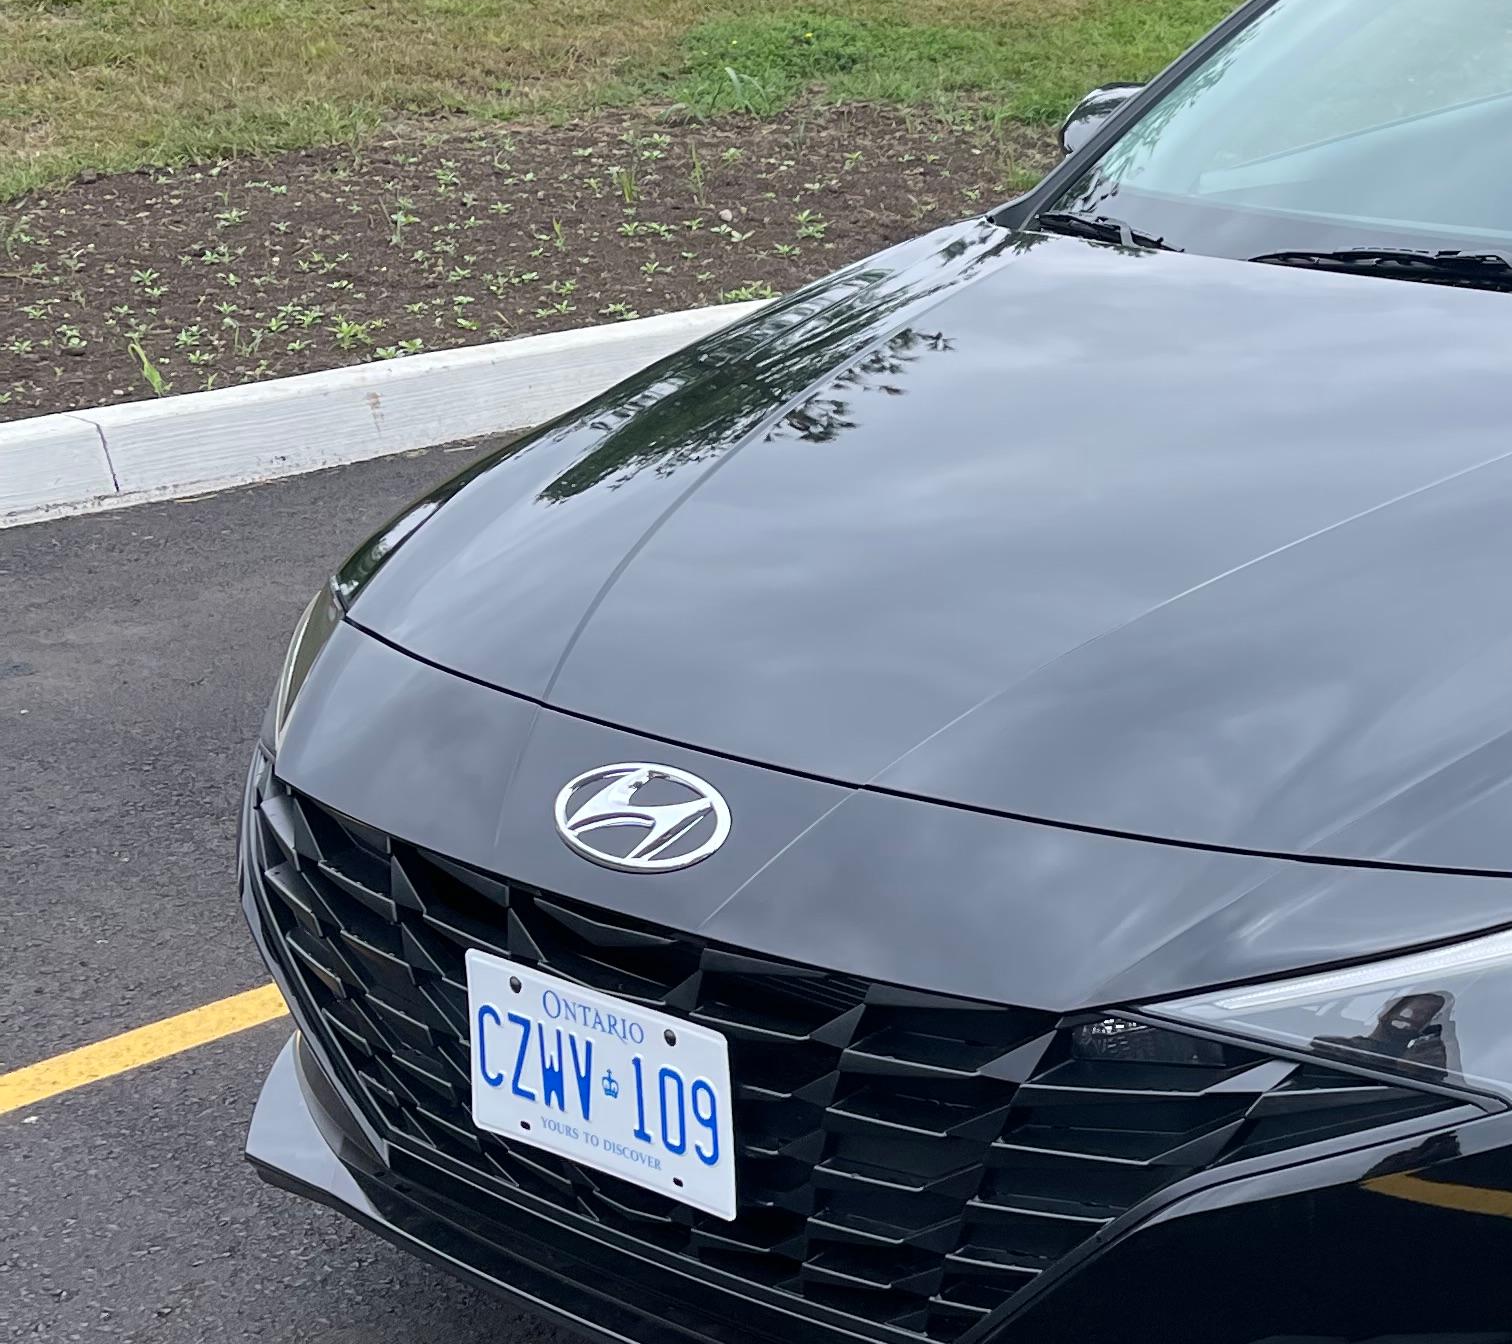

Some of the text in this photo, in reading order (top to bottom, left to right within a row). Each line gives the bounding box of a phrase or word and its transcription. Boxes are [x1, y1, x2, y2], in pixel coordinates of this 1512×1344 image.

[542, 990, 645, 1045] ONTARIO
[478, 1005, 720, 1166] CZWV 109
[540, 1116, 662, 1171] YOURS TO DISCOVER
